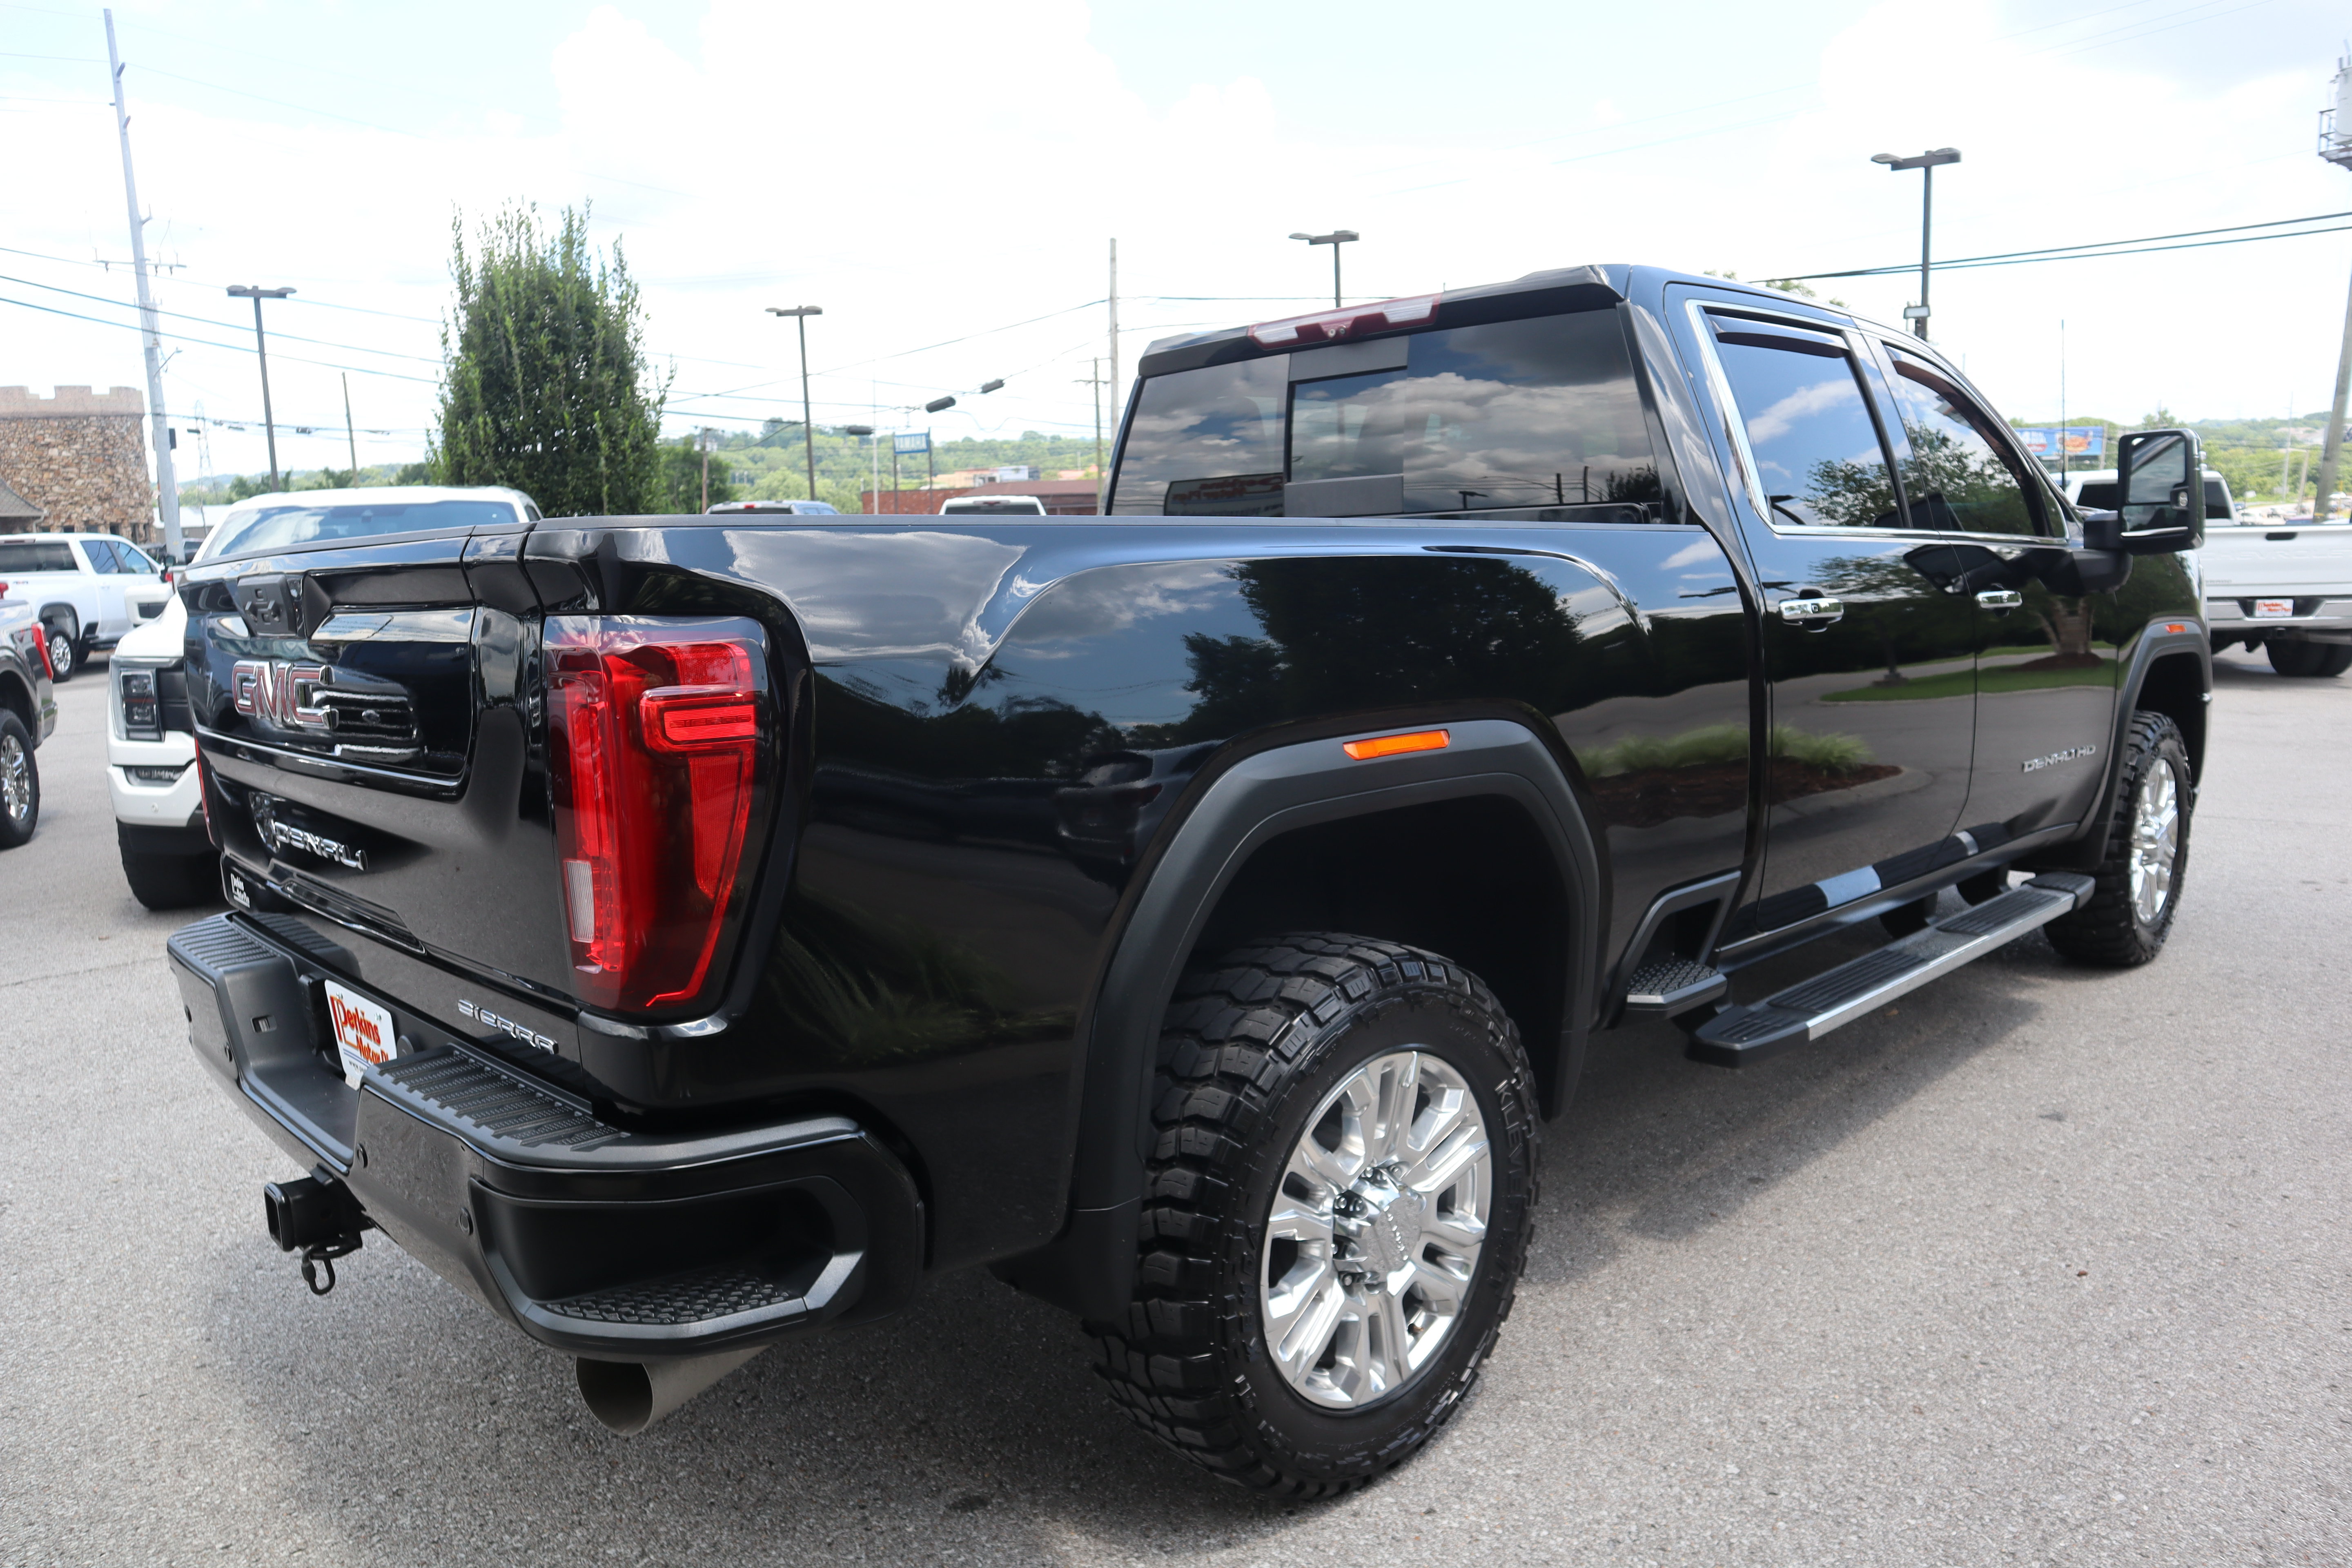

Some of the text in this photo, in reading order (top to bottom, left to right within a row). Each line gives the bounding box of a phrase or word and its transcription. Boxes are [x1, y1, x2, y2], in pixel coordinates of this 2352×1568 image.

[232, 660, 339, 730] GMC
[670, 715, 752, 728] SIERRA
[2022, 744, 2096, 773] DENALI HD
[274, 822, 368, 871] DENALI
[330, 995, 381, 1046] Perkins
[458, 999, 559, 1055] SIERRA
[1494, 1079, 1524, 1220] KLEVER
